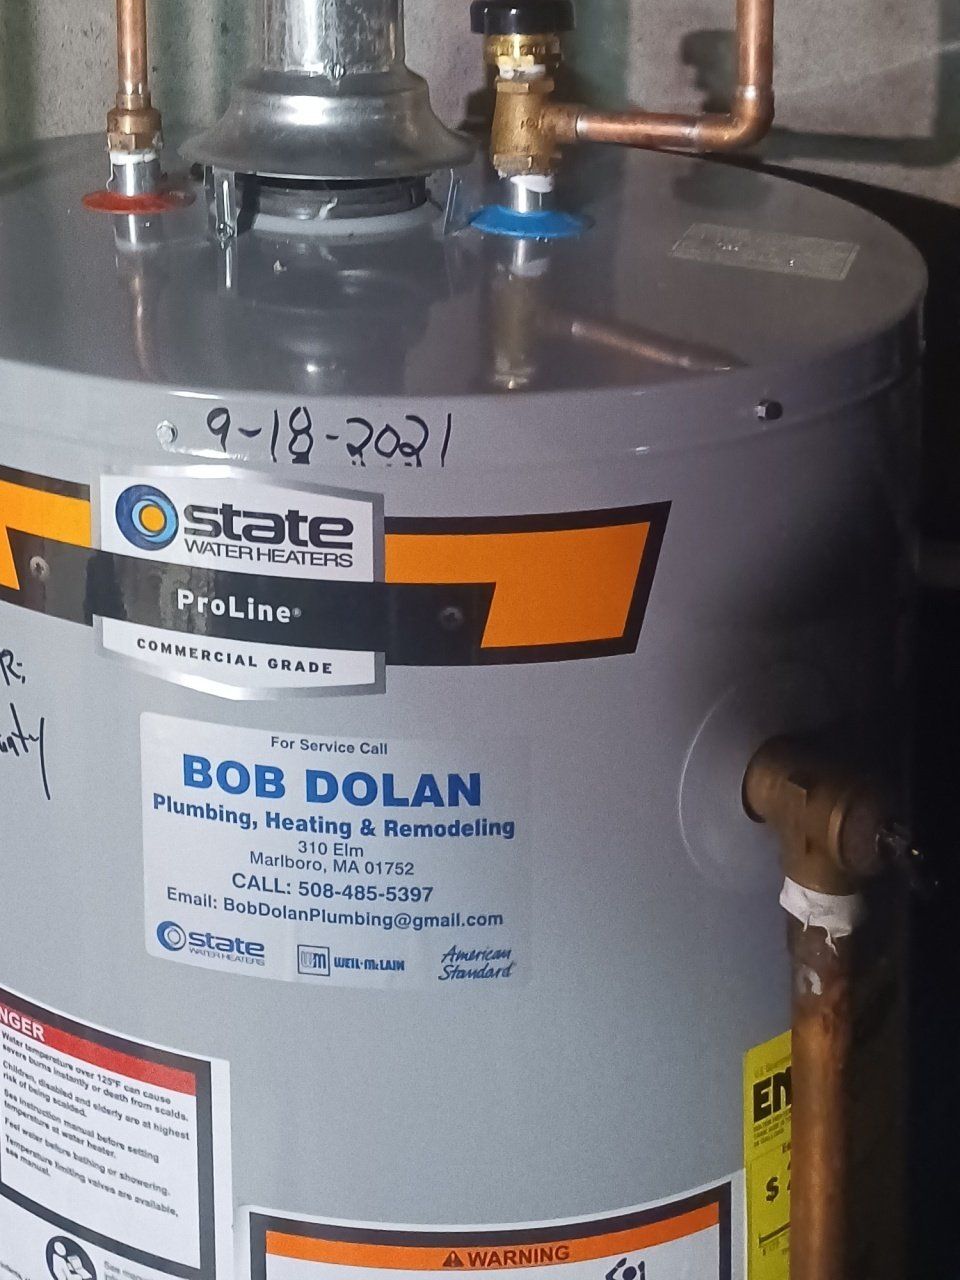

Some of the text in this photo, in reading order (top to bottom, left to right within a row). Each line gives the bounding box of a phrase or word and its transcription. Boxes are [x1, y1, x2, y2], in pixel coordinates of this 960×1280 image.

[206, 406, 452, 468] 9-18-2021
[183, 503, 354, 550] state
[184, 538, 353, 568] WATER HEATERS
[137, 638, 333, 675] COMMERCIAL GRADE
[271, 736, 388, 755] For Service Call
[182, 753, 482, 808] BOB DOLAN
[153, 793, 515, 840] Plumbing, Heating & Remodeling
[249, 850, 415, 876] Marlboro, MA 01752
[297, 840, 364, 858] 310 Elm
[166, 886, 504, 931] Email: BobDolanPlumbing@gmail.com
[231, 872, 434, 904] CALL: 508-485-5397
[188, 930, 265, 958] state
[440, 944, 512, 963] American
[438, 964, 513, 981] Standard
[1, 1030, 23, 1048] Water
[24, 1042, 74, 1070] temperature
[75, 1066, 95, 1080] over
[124, 1084, 141, 1096] can
[143, 1090, 171, 1104] cause
[2, 1043, 26, 1062] severe
[91, 1084, 101, 1093] or
[103, 1087, 129, 1103] death
[130, 1096, 152, 1111] from
[154, 1104, 189, 1122] scalds.
[3, 1072, 17, 1084] risk
[19, 1080, 27, 1090] of
[28, 1084, 51, 1102] being
[3, 1100, 50, 1129] temperature
[51, 1124, 60, 1134] at
[62, 1131, 85, 1146] water
[3, 1088, 159, 1163] See instruction manual before setting
[39, 1077, 73, 1101] disabled
[75, 1094, 91, 1107] and
[92, 1100, 123, 1121] elderly
[125, 1114, 140, 1125] are
[142, 1119, 152, 1130] at
[153, 1123, 190, 1140] highest
[4, 1116, 20, 1131] Feel
[22, 1128, 43, 1143] water
[44, 1138, 71, 1157] before
[72, 1151, 106, 1174] bathing
[107, 1167, 117, 1176] or
[5, 1134, 53, 1166] Temperature
[54, 1160, 86, 1184] limiting
[88, 1177, 116, 1195] valves
[117, 1190, 133, 1201] are
[467, 1244, 571, 1267] WARNING
